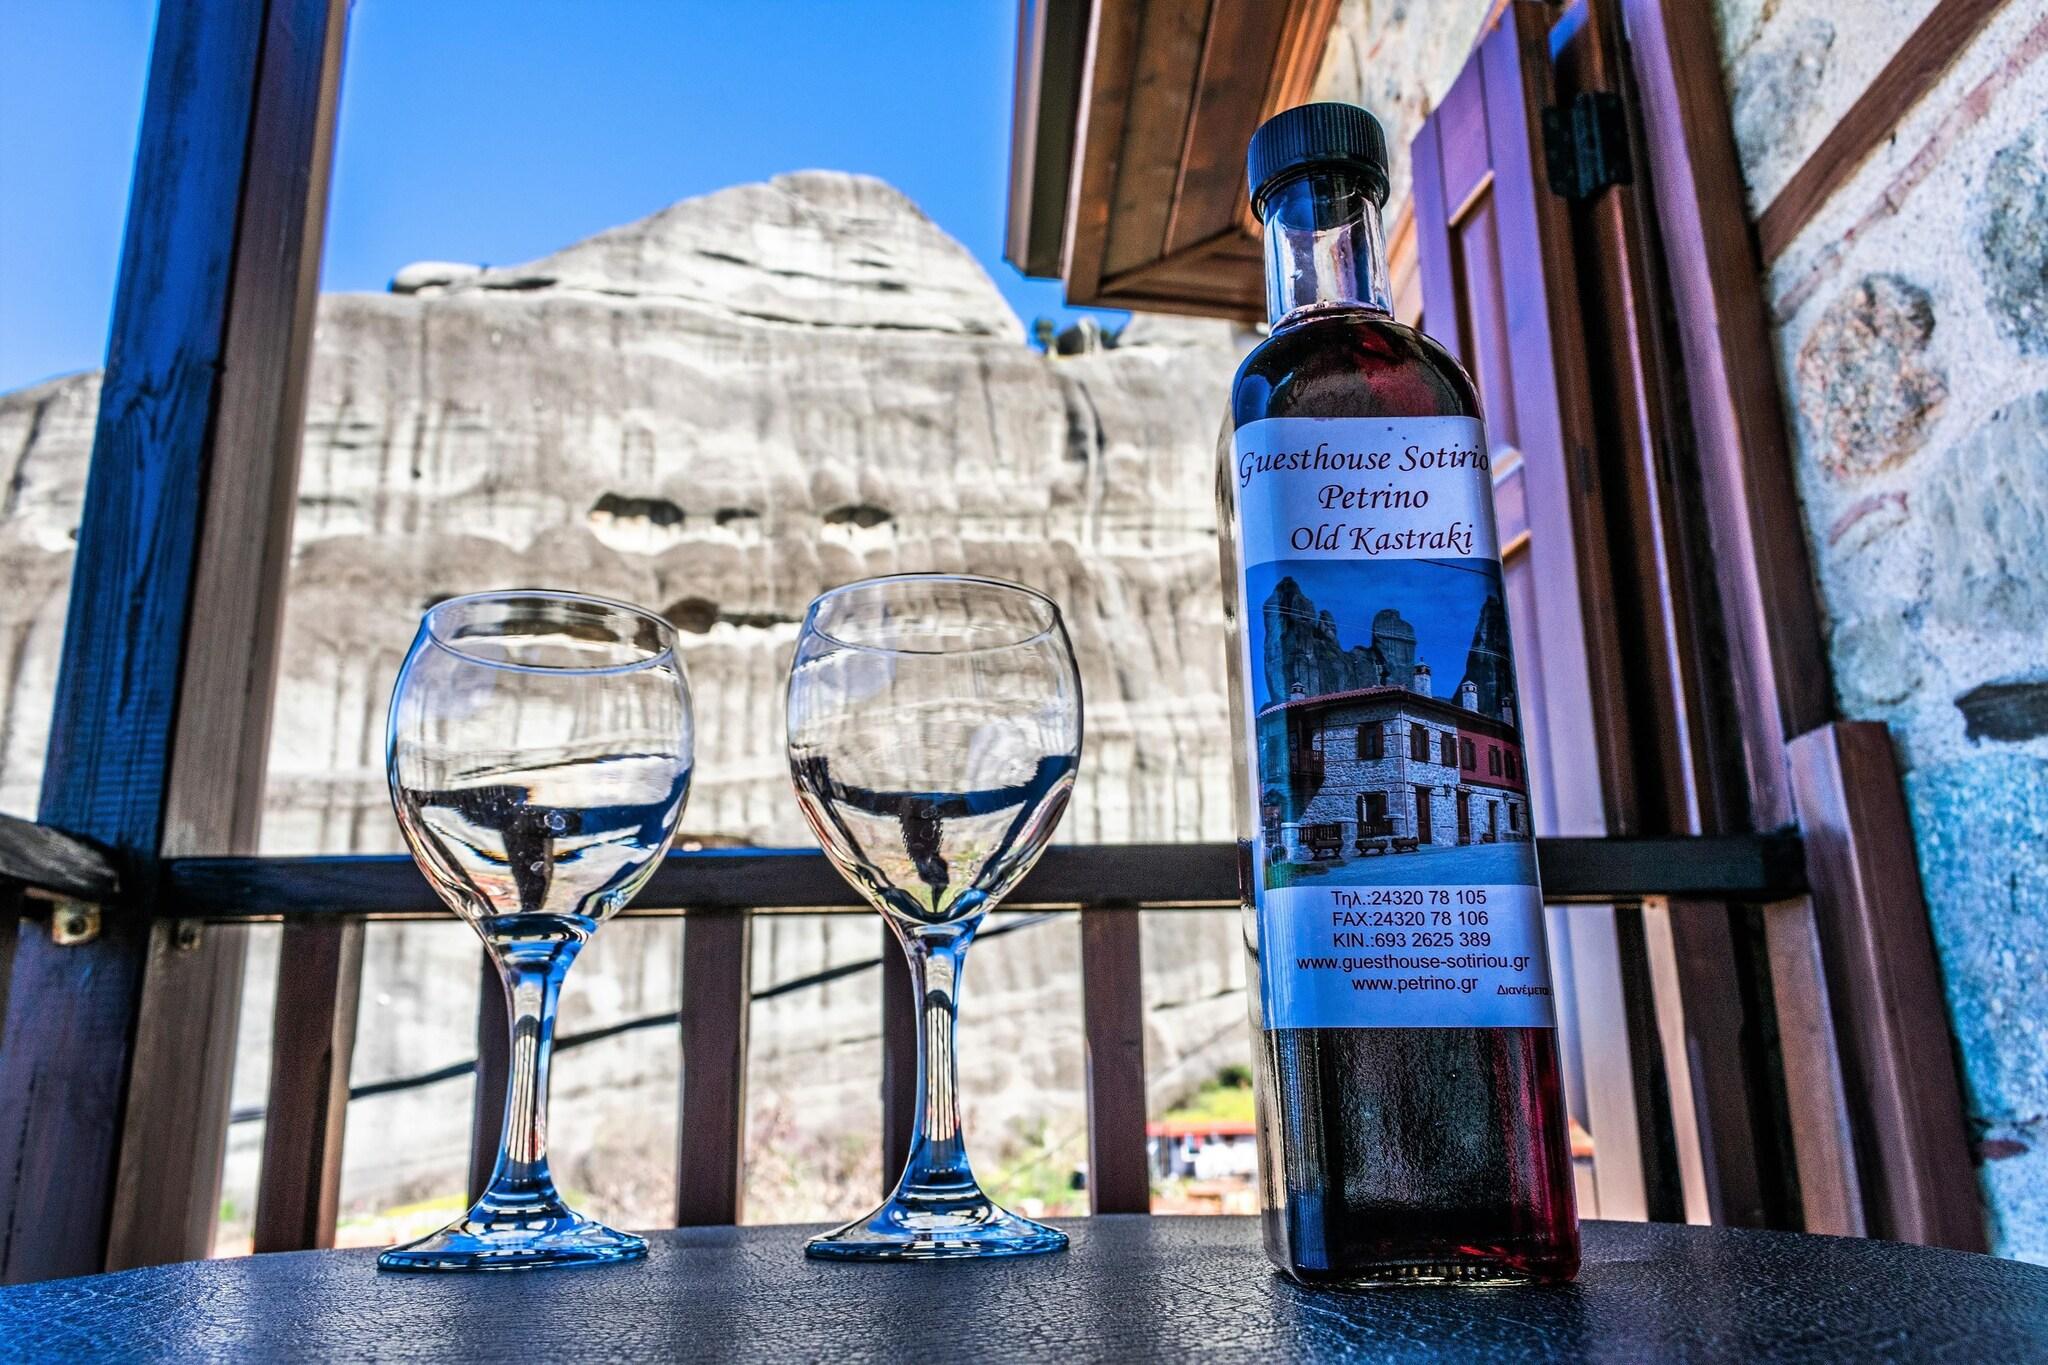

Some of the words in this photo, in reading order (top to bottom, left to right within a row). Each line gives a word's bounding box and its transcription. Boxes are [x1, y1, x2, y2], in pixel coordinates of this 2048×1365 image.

[1240, 443, 1391, 488] Guesthouse
[1318, 483, 1429, 510] Petrino
[1291, 524, 1346, 551] Old
[1349, 522, 1474, 555] Kastraki
[1430, 890, 1450, 905] 78
[1456, 890, 1487, 905] 105
[1332, 911, 1425, 928] FAX:24320
[1430, 911, 1452, 926] 78
[1458, 911, 1489, 926] 106
[1412, 932, 1454, 948] 2625
[1459, 932, 1491, 947] 389
[1297, 954, 1530, 972] www.guesthouse-sotiriou.gr
[1351, 976, 1478, 994] www.petrino.gr
